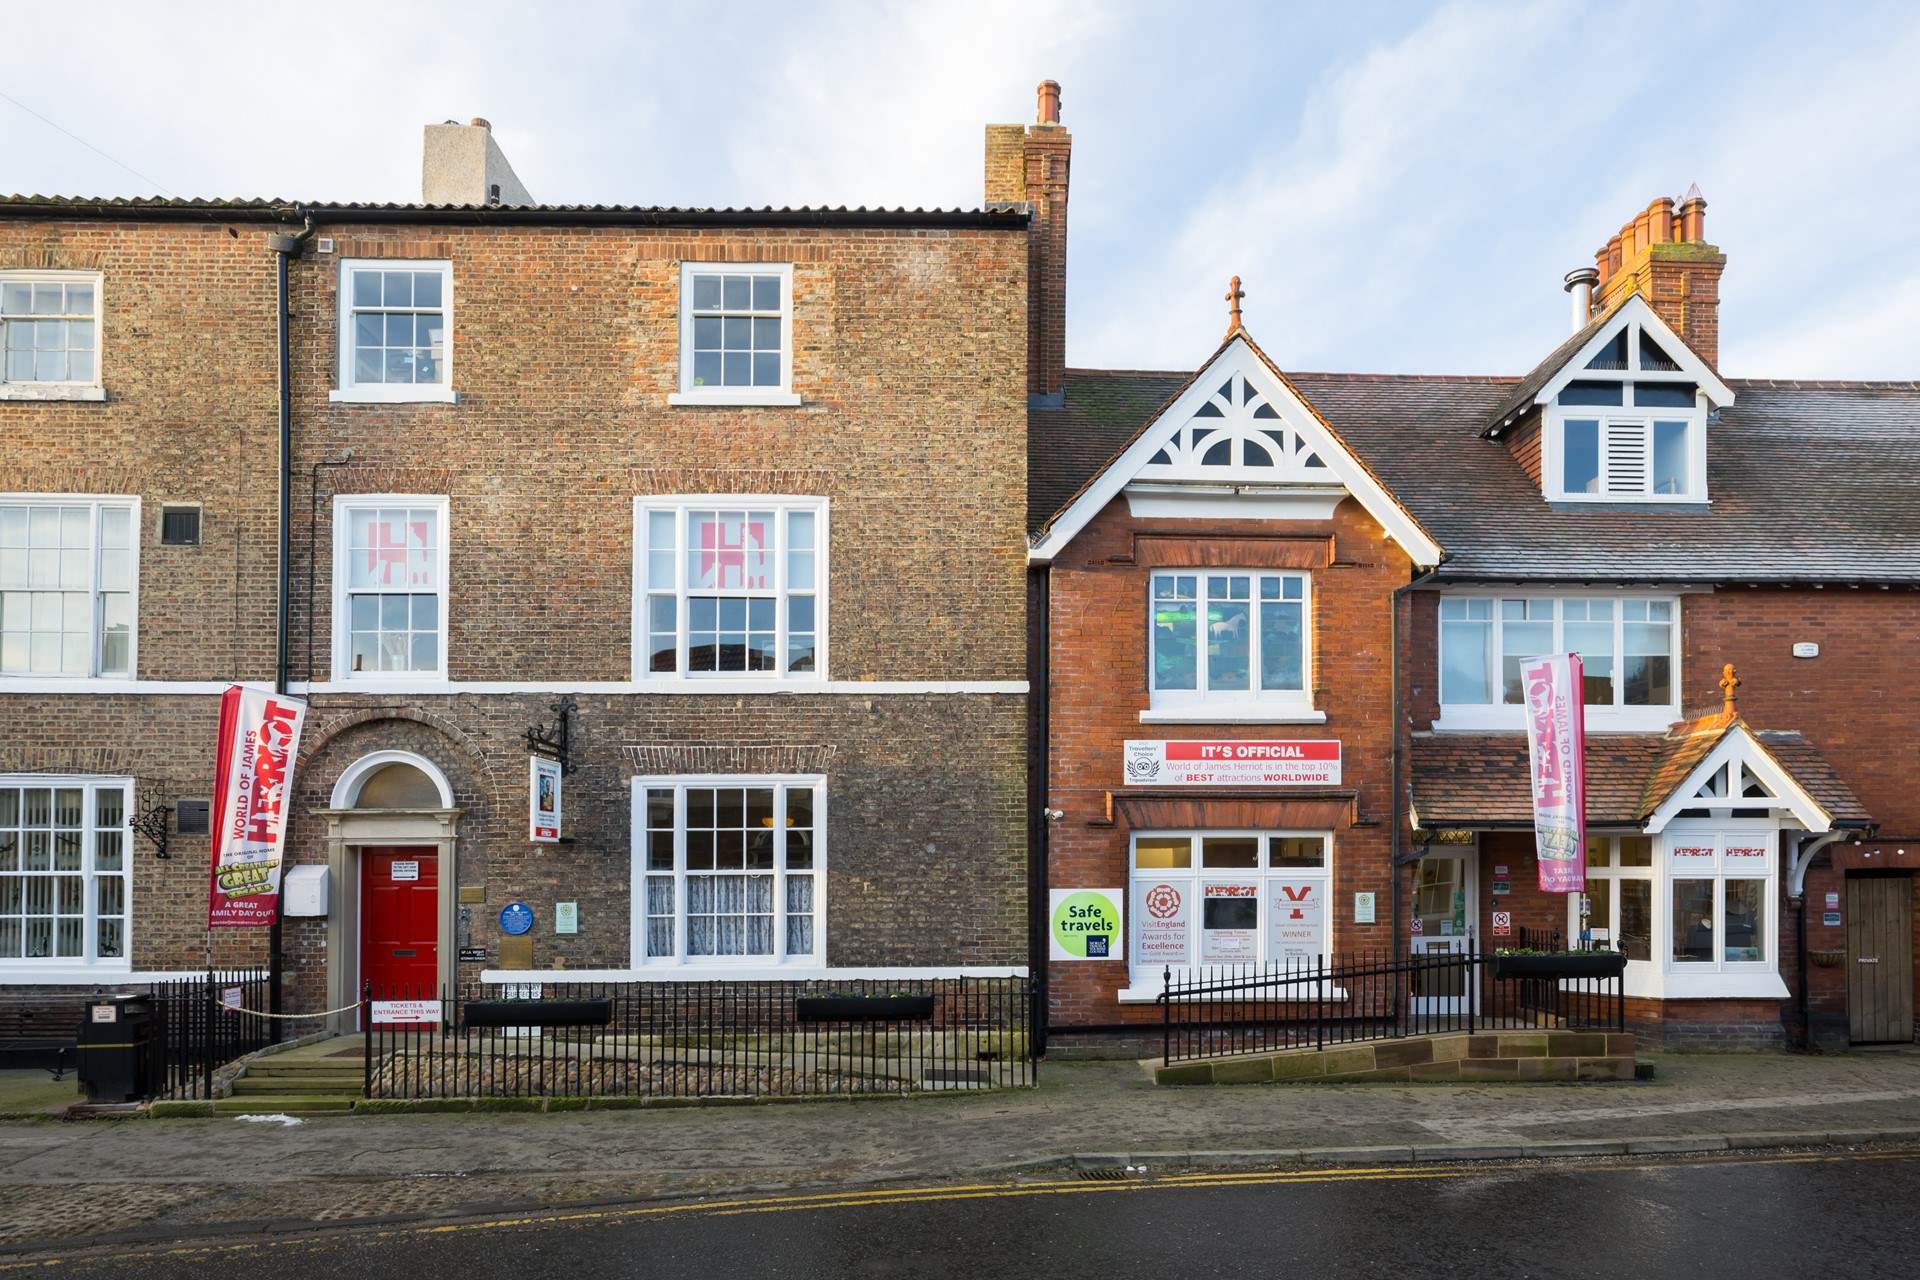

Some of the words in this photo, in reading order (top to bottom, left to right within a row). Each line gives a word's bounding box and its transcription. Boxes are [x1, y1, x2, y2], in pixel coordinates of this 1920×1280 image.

[242, 730, 257, 770] JAMES
[1201, 745, 1232, 758] IT'S
[1236, 745, 1305, 758] OFFICIAL
[247, 699, 298, 843] HERRIOT
[1167, 762, 1192, 771] World
[1193, 762, 1203, 771] of
[1204, 762, 1231, 771] James
[1234, 762, 1263, 771] Herriot
[1265, 762, 1272, 771] is
[1275, 762, 1283, 771] in
[1285, 762, 1299, 771] the
[1301, 762, 1315, 772] top
[1318, 762, 1338, 771] 10%
[239, 773, 250, 790] OF
[1174, 773, 1183, 782] of
[1186, 773, 1214, 782] BEST
[1216, 773, 1260, 782] attractions
[1263, 773, 1329, 782] WORLDWIDE
[233, 795, 249, 840] WORLD
[1674, 848, 1714, 857] HERRIOT
[1726, 848, 1766, 857] HERRIOT
[219, 867, 269, 890] GREAT
[1205, 886, 1257, 897] HERRIOT
[233, 901, 259, 909] GREAT
[211, 909, 237, 917] AMILY
[238, 909, 255, 917] DAY
[1069, 904, 1102, 918] Safe
[1061, 917, 1113, 931] travels
[1141, 920, 1186, 929] VisitEngland
[1142, 932, 1172, 941] Awards
[1174, 932, 1185, 940] for
[1281, 930, 1312, 938] WINNER
[1142, 942, 1185, 950] Excellence
